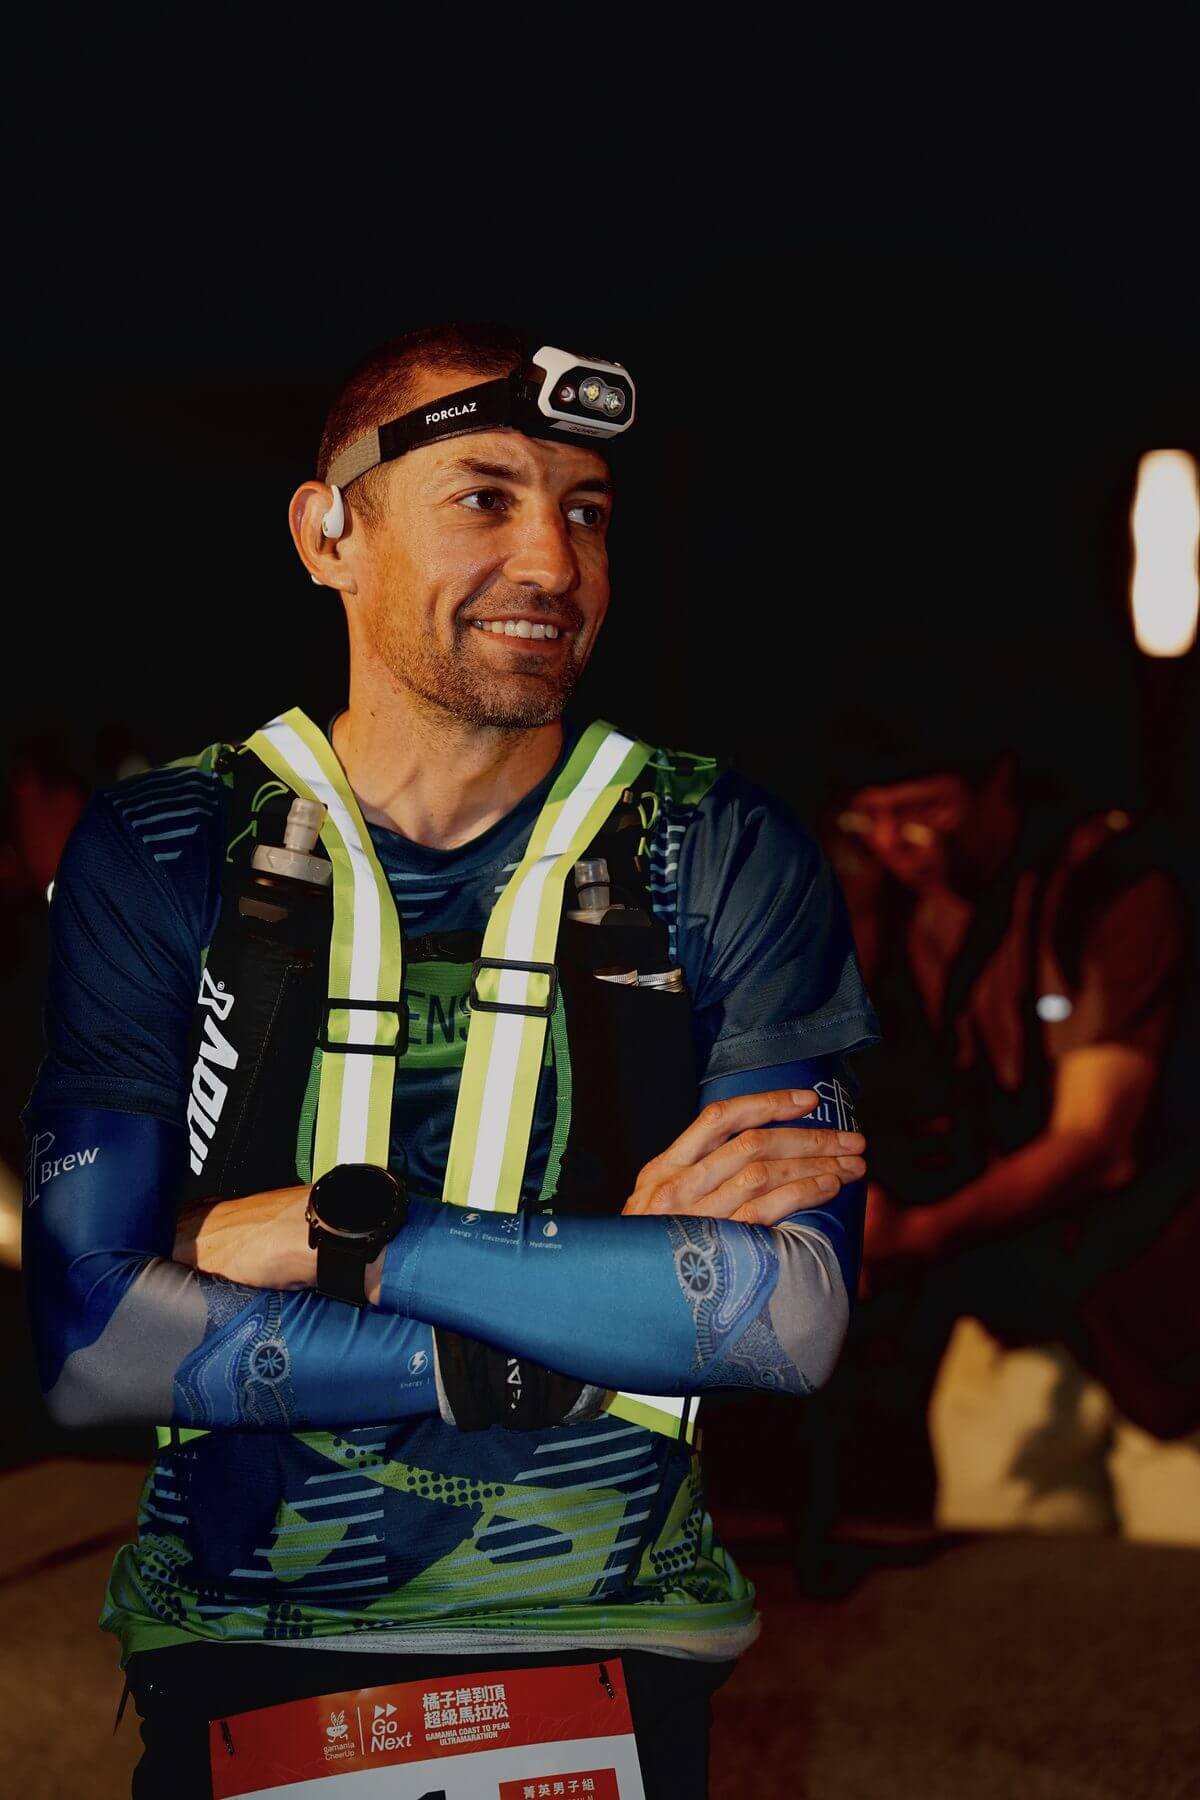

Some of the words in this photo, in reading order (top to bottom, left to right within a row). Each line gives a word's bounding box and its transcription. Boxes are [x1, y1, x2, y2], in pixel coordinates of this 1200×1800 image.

[425, 402, 477, 425] FORCLAZ
[40, 1146, 100, 1184] Brew
[449, 1228, 472, 1239] Energy
[529, 1240, 562, 1250] Hydration
[422, 1684, 506, 1711] 橘子岸到頂
[424, 1701, 509, 1729] 超級馬拉松
[371, 1718, 398, 1736] Go
[425, 1729, 457, 1741] GAMANIA
[458, 1725, 480, 1736] COAST
[482, 1724, 491, 1732] TO
[492, 1721, 511, 1731] PEAK
[440, 1730, 499, 1746] ULTRAMARATHON
[323, 1741, 355, 1754] gamania
[370, 1731, 413, 1753] Next
